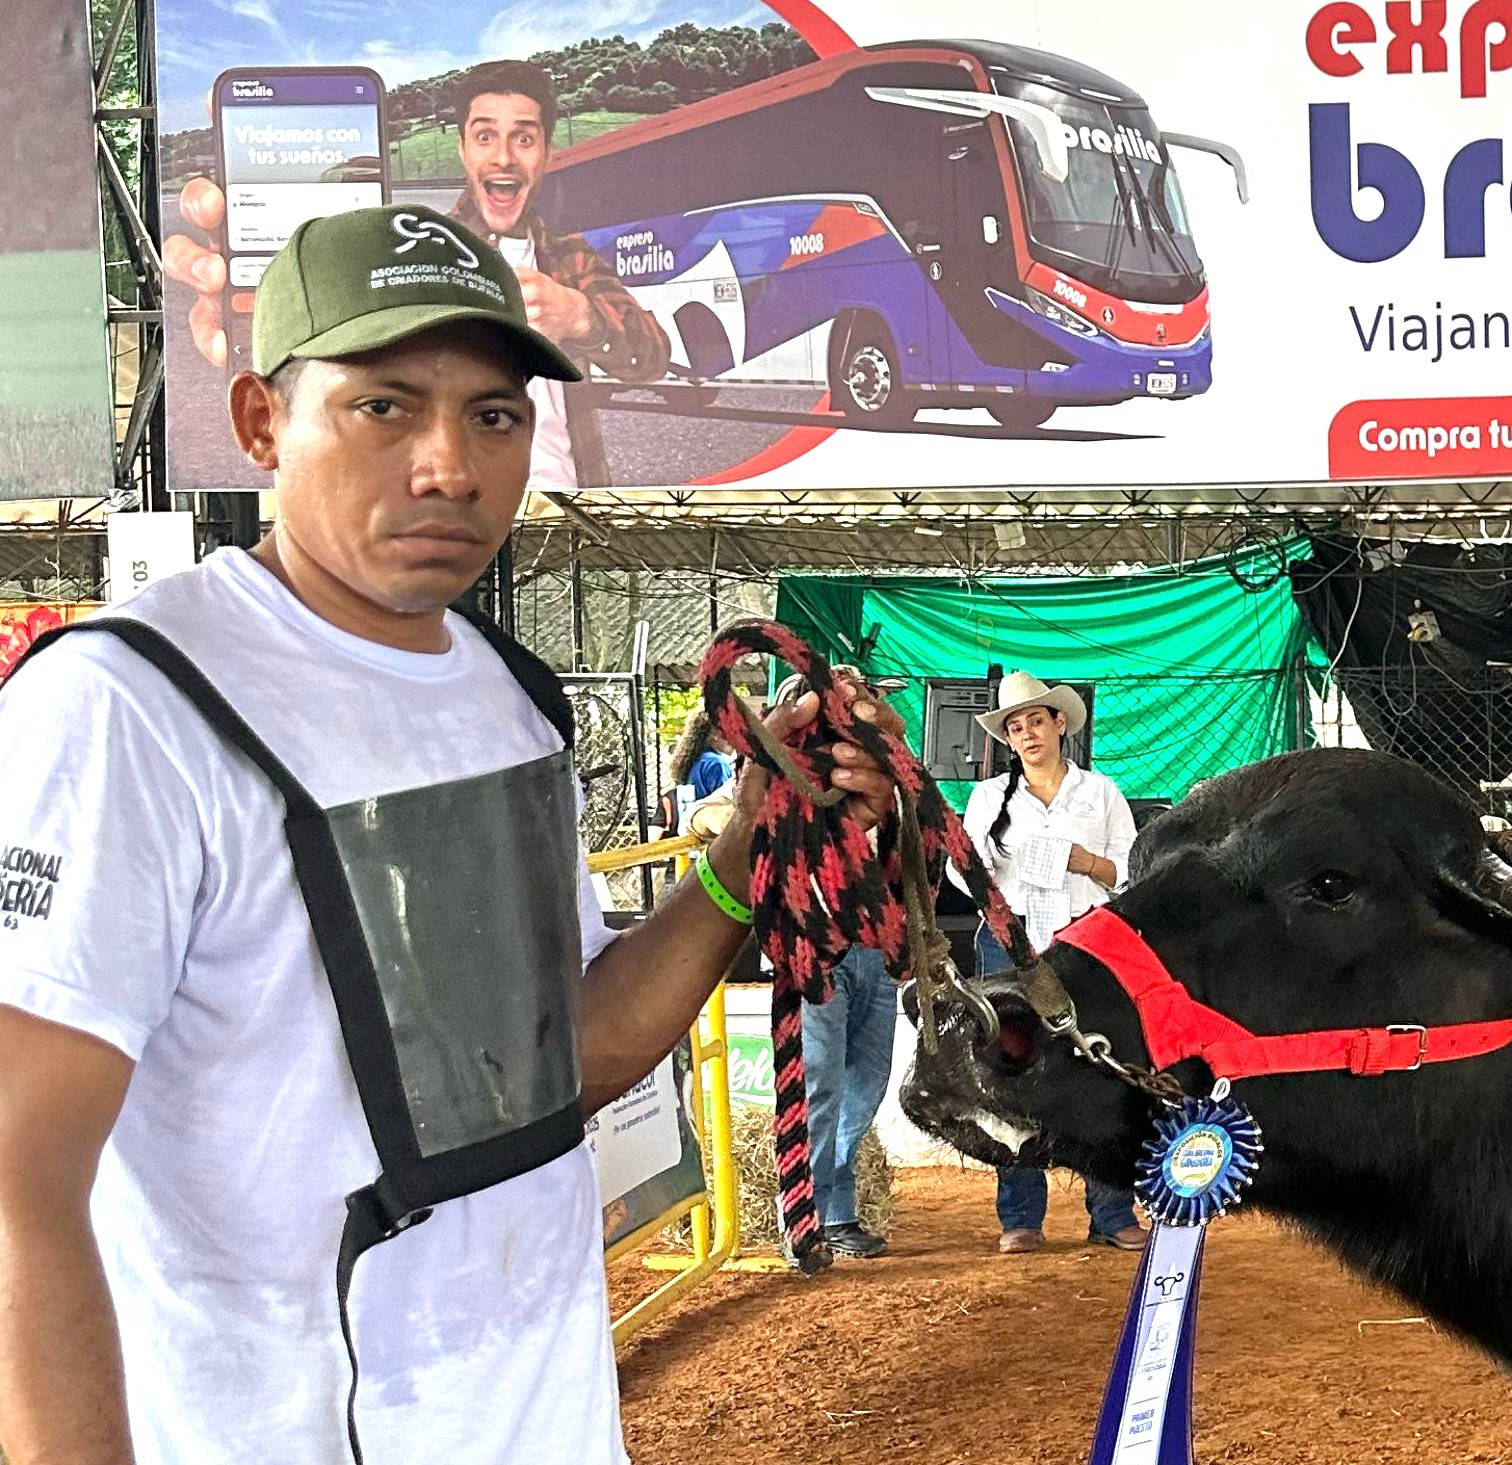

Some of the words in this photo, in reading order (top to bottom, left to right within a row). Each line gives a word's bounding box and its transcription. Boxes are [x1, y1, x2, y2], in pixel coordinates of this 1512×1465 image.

[235, 124, 324, 147] Viajamos
[326, 127, 361, 143] con
[249, 146, 277, 165] tus
[616, 230, 654, 251] expreso
[789, 232, 824, 255] 10008
[616, 243, 674, 277] brasilia
[1053, 280, 1087, 308] 10008
[1358, 420, 1481, 457] Compra
